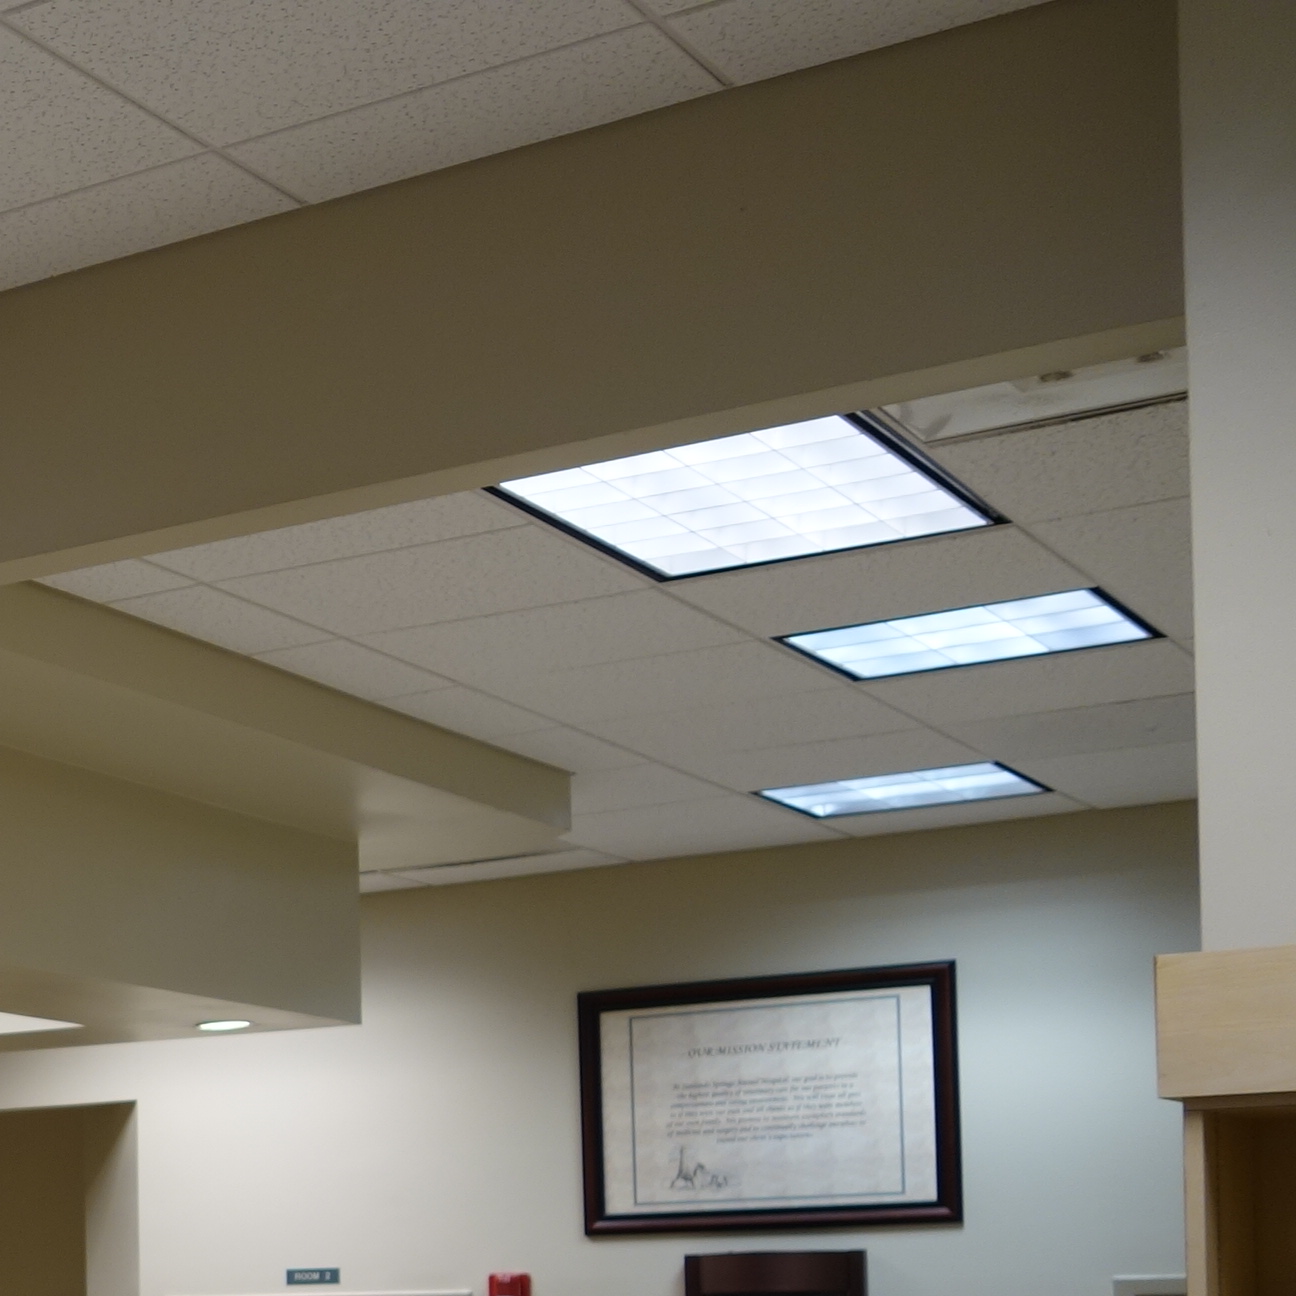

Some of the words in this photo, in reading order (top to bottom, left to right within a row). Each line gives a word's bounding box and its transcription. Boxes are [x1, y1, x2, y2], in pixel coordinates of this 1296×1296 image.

[717, 1043, 765, 1057] MISSION
[767, 1037, 842, 1054] STATEMENT
[294, 1271, 320, 1281] ROOM
